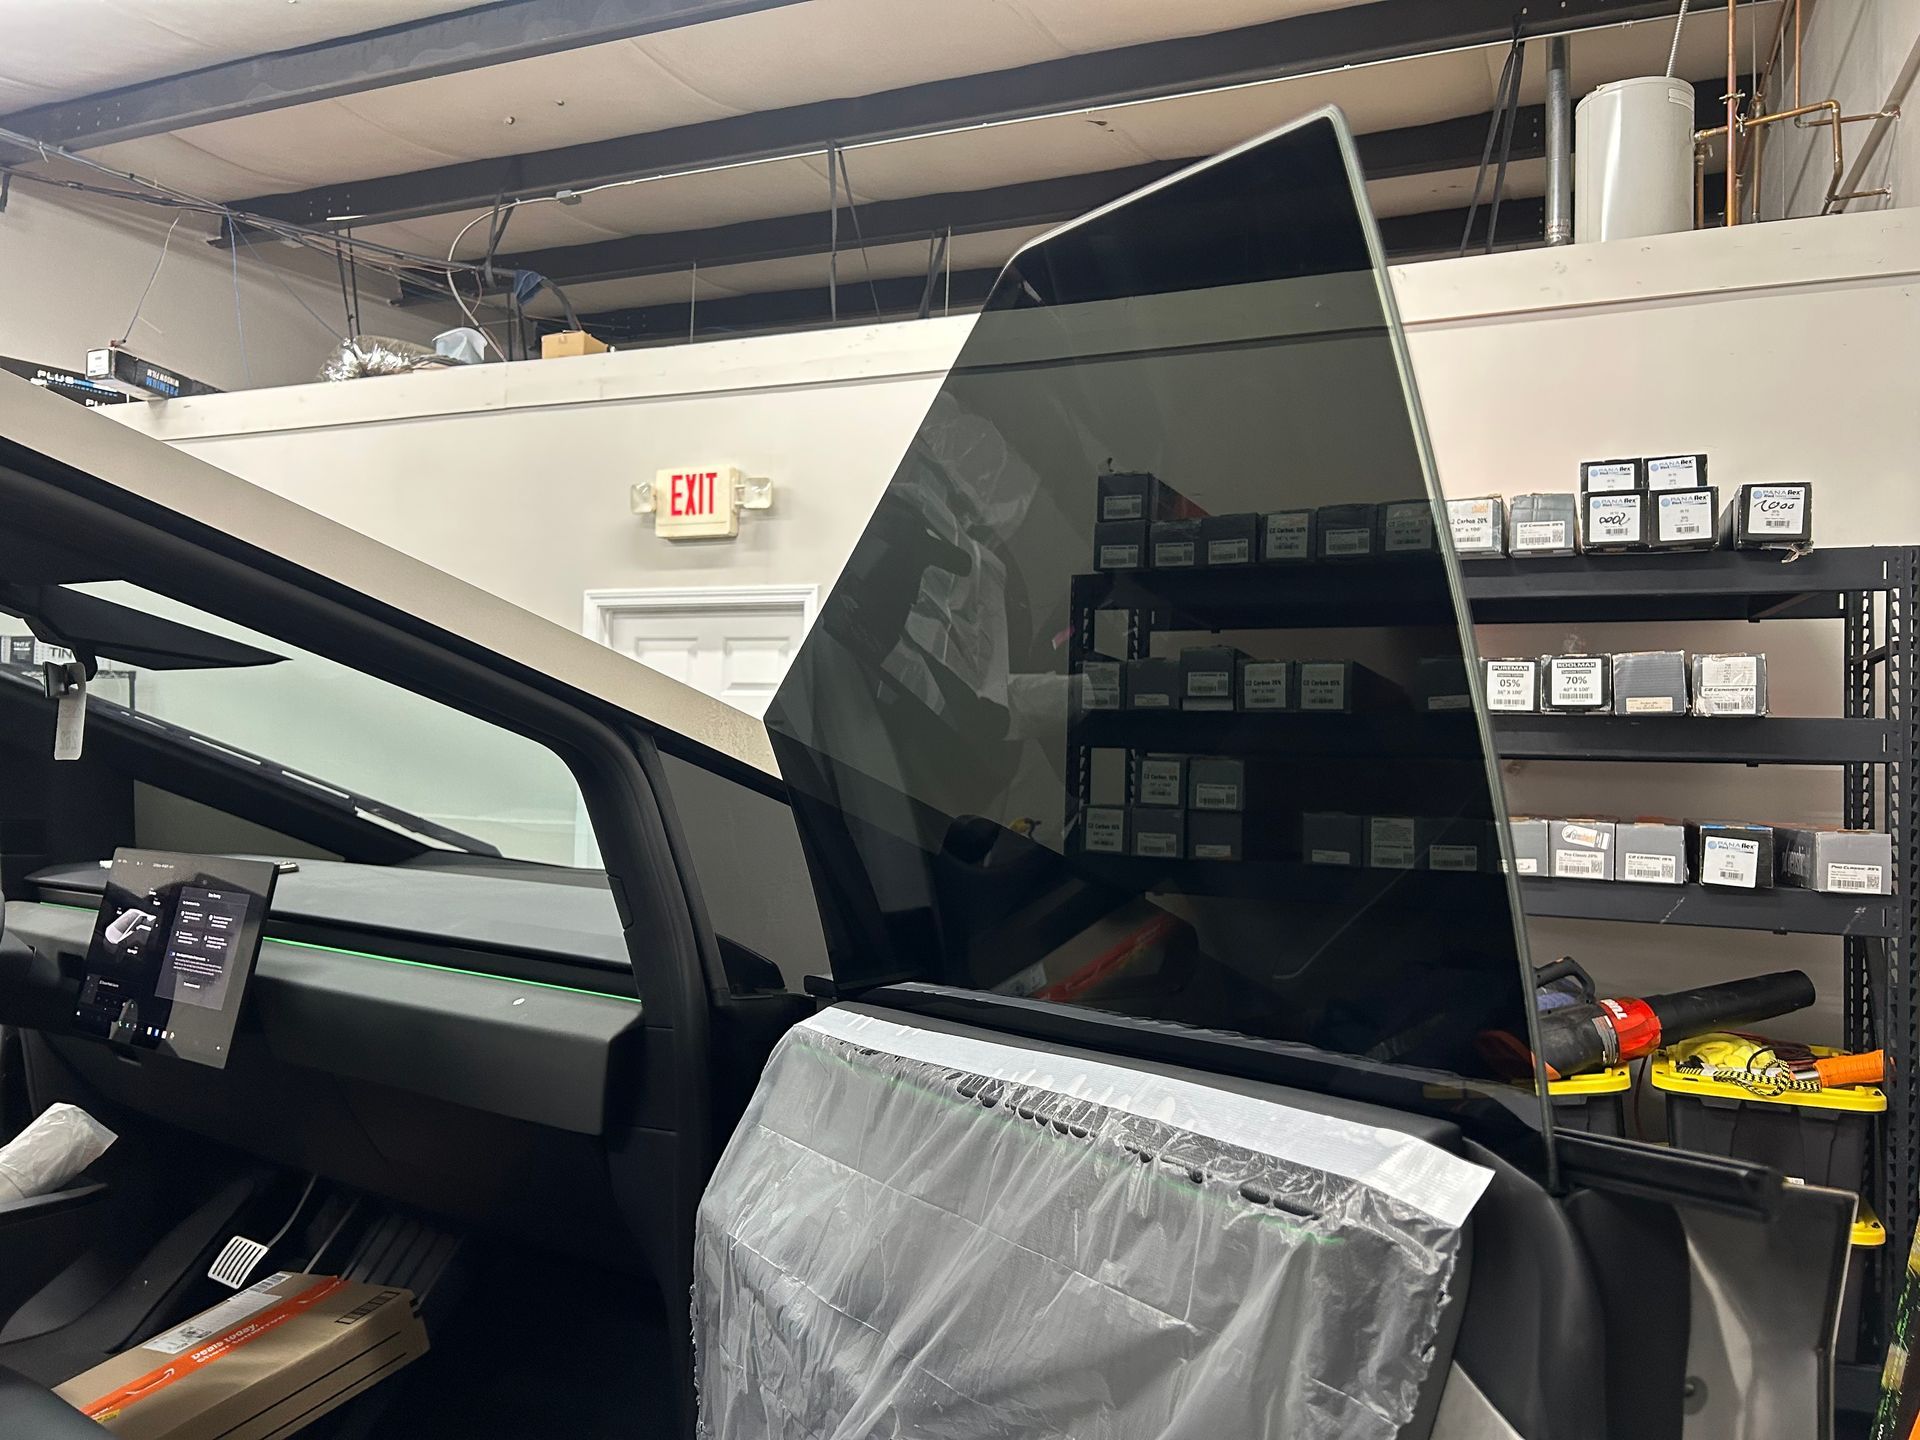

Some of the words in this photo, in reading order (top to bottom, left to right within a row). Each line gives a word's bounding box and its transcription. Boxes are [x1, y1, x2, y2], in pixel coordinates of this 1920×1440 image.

[37, 369, 74, 384] PLUS
[671, 473, 717, 516] EXIT
[1500, 679, 1520, 687] 05%
[1566, 676, 1587, 684] 70%
[191, 1341, 224, 1360] Deals
